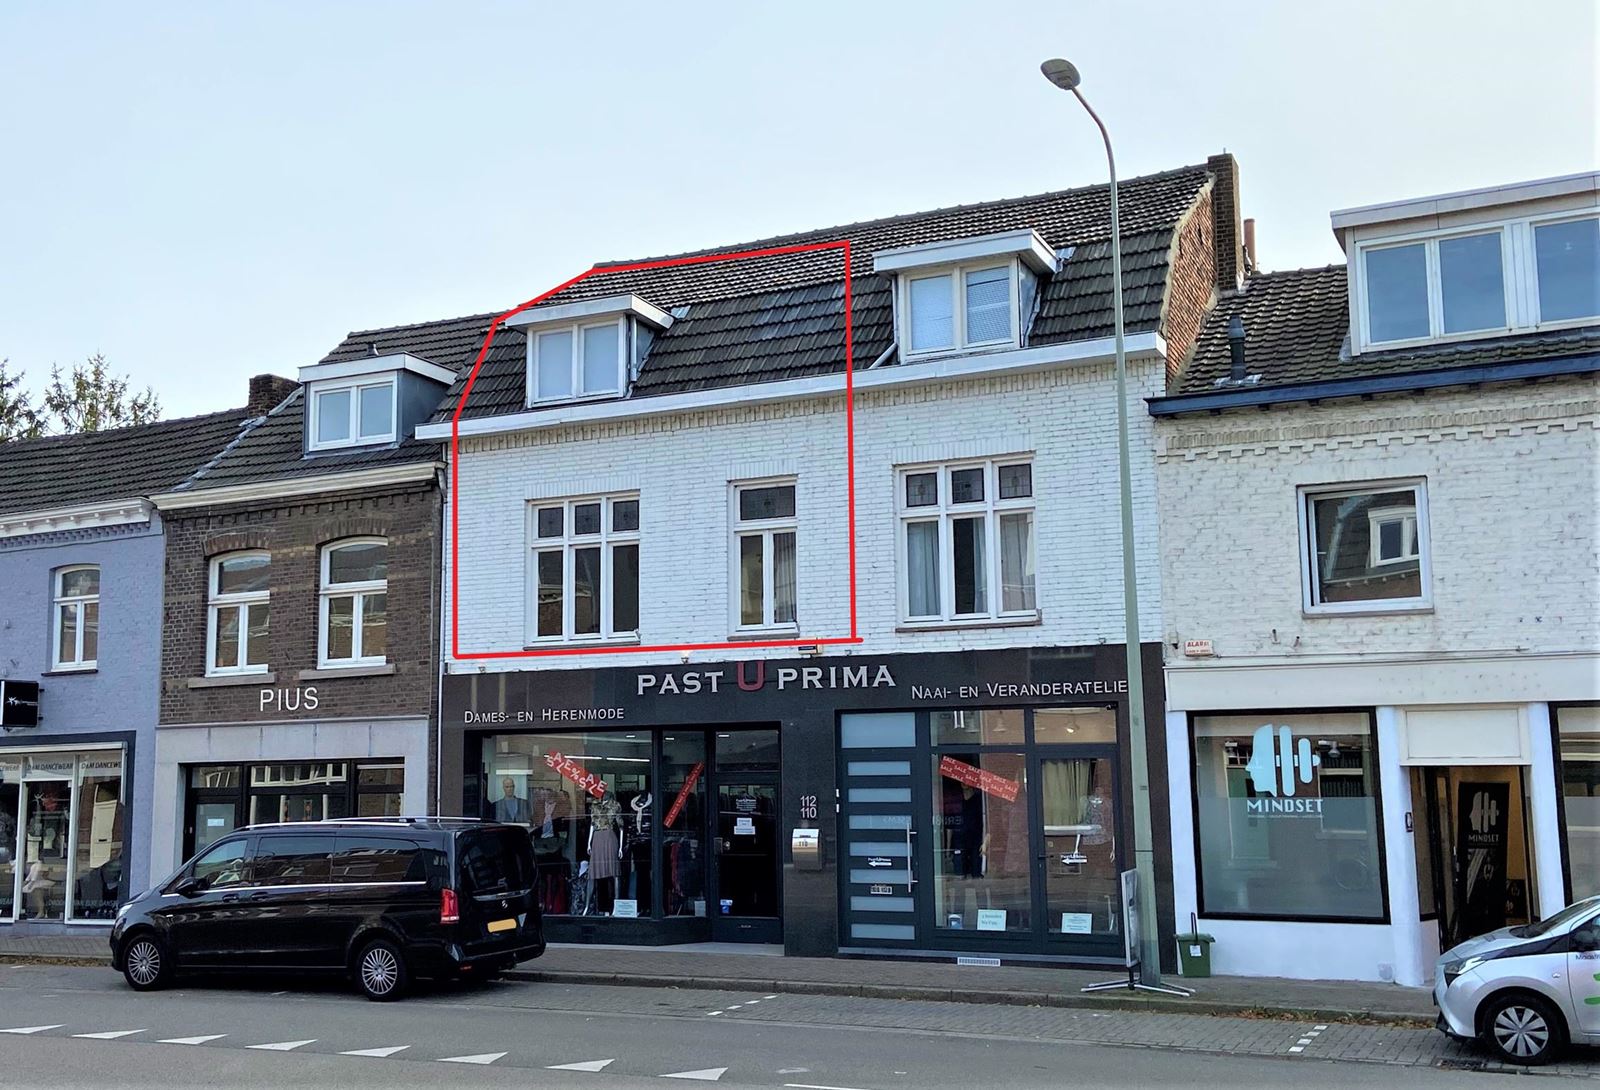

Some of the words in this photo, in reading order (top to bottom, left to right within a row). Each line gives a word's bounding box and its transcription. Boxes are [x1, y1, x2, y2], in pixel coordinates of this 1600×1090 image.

[637, 671, 724, 695] PAST
[736, 660, 765, 691] U
[777, 665, 897, 690] PRIMA
[911, 685, 951, 699] NAAI-
[959, 686, 979, 698] EN
[986, 680, 1129, 697] VERANDERATELIE
[260, 686, 319, 711] PIUS
[464, 711, 509, 723] DAMES-
[517, 711, 533, 721] EN
[542, 708, 625, 721] HERENMODE
[546, 752, 574, 774] SALE
[579, 773, 608, 795] SALE
[800, 795, 817, 807] 112
[1247, 799, 1324, 812] MINDSET
[800, 807, 817, 819] 110
[1468, 834, 1499, 842] MINDSET
